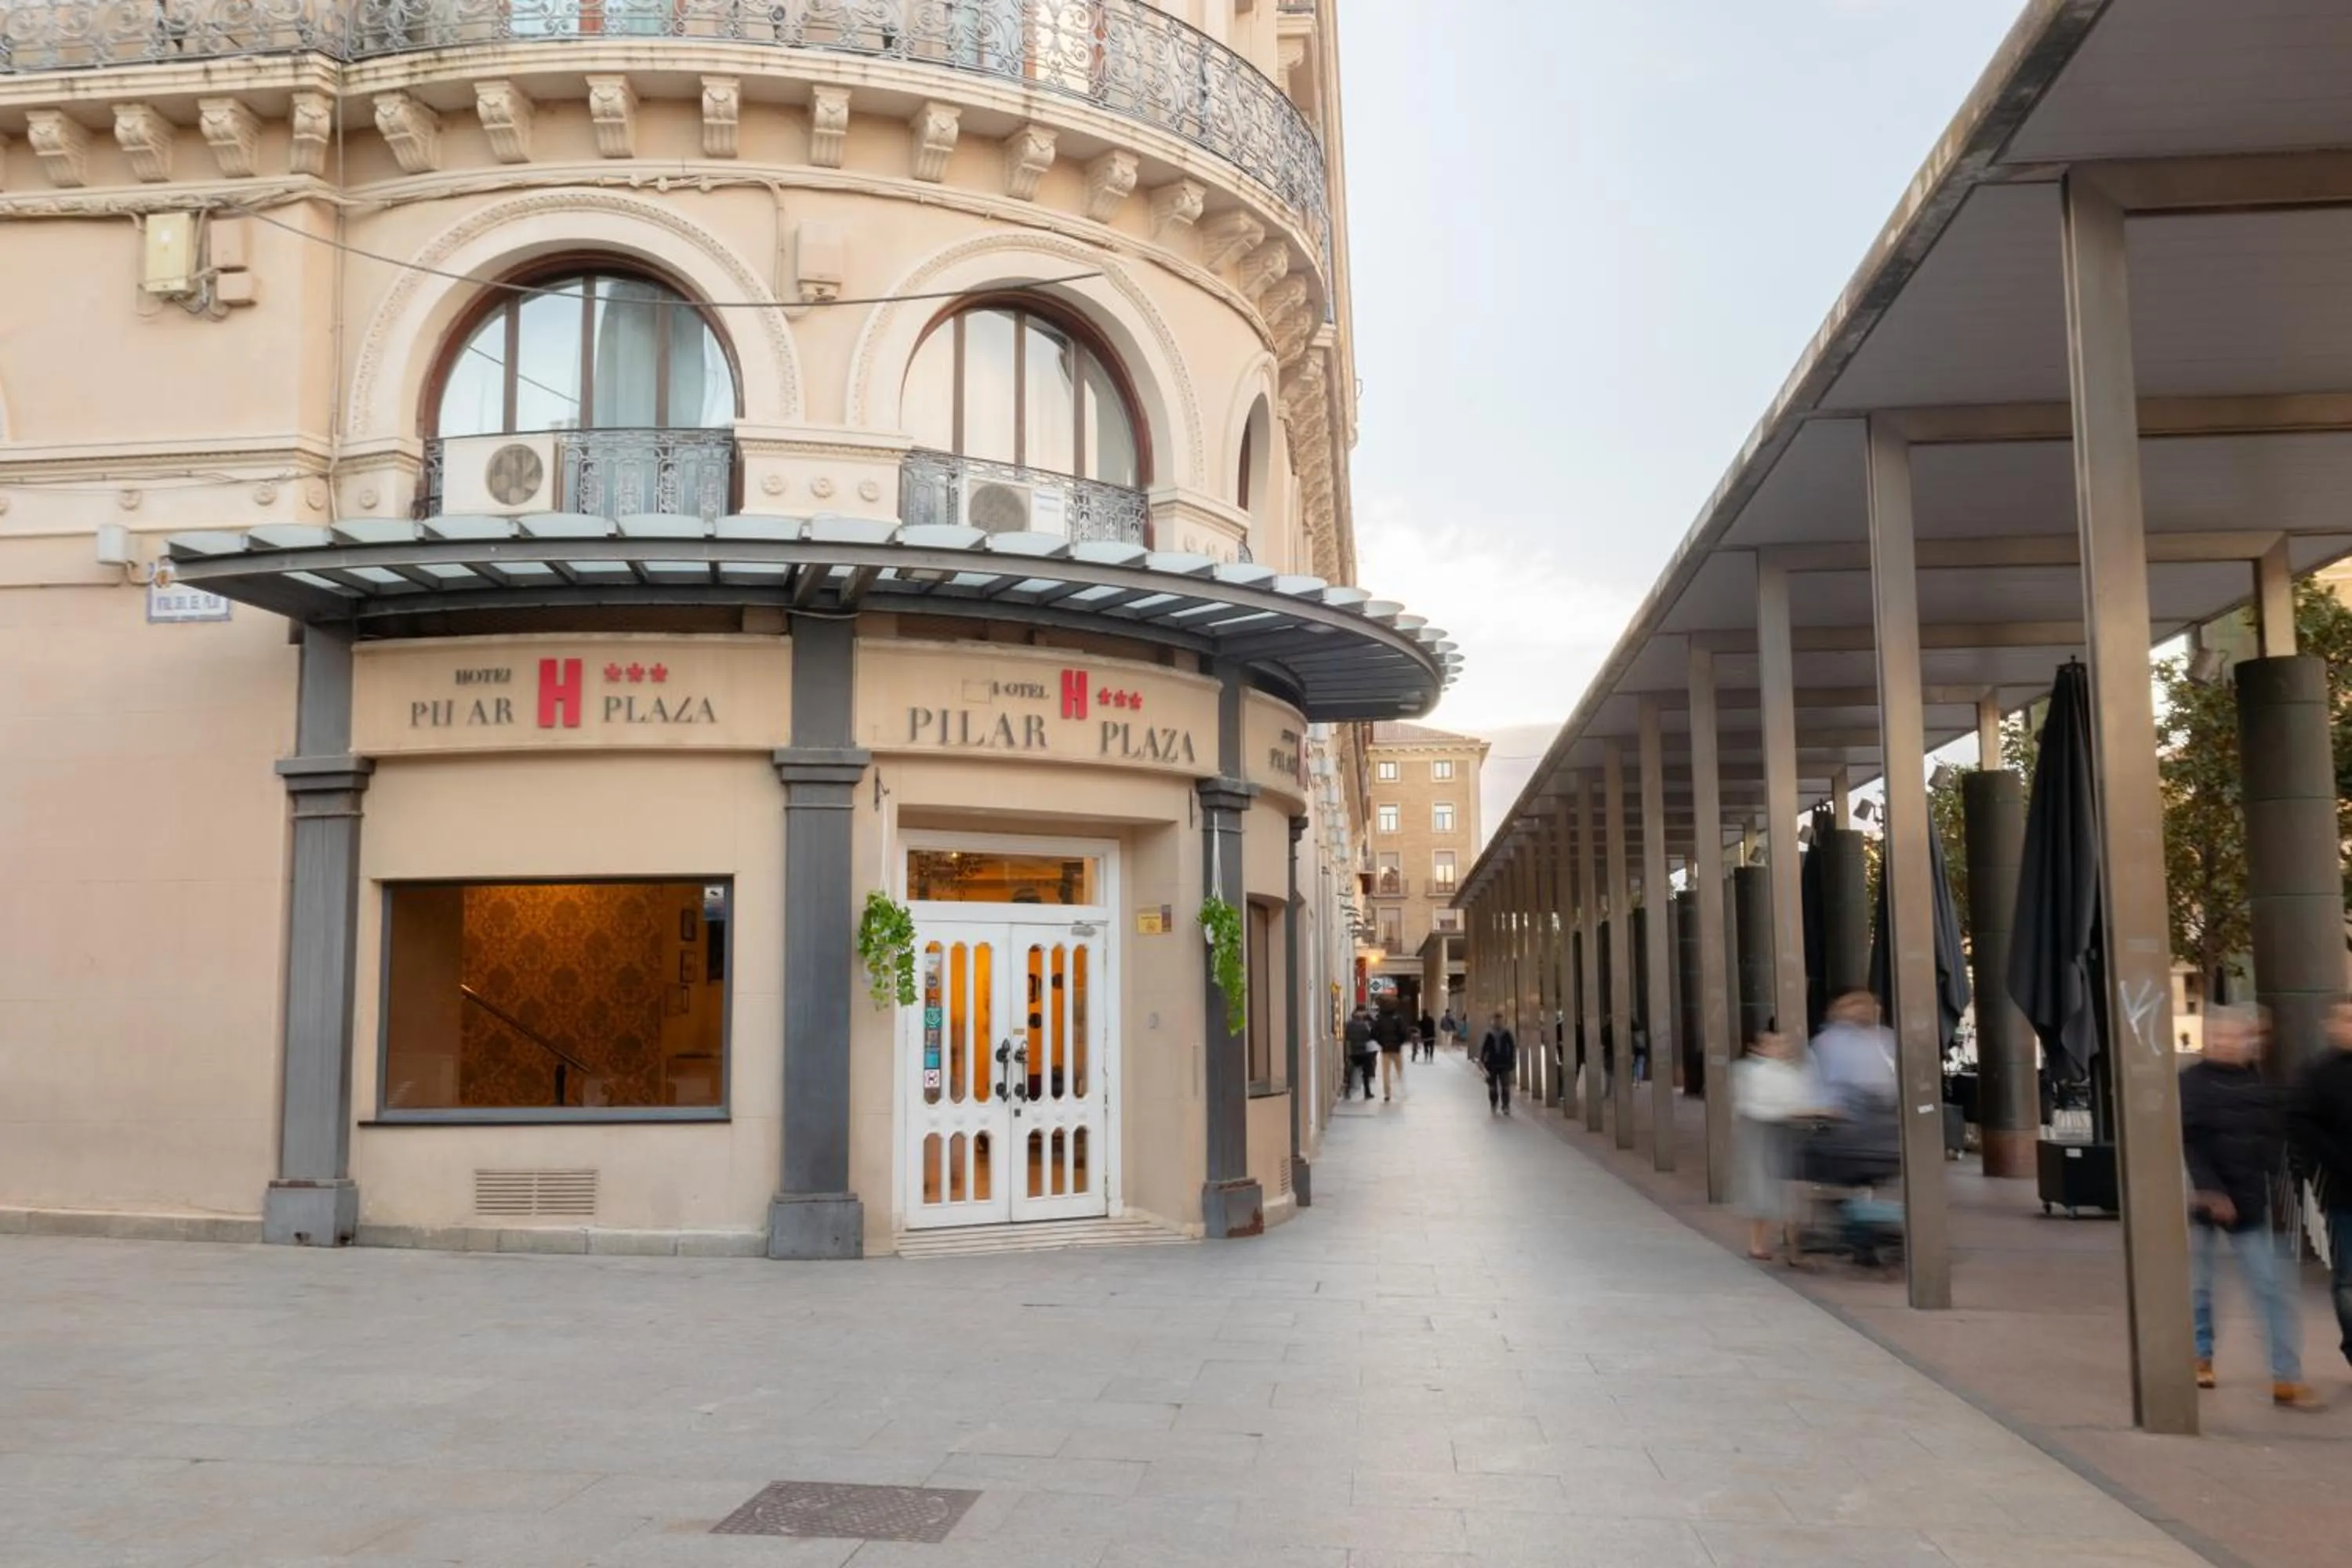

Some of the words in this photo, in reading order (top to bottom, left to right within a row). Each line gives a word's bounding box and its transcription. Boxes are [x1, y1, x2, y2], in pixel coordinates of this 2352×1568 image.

[538, 658, 582, 728] H
[602, 694, 717, 724] PLAZA
[1061, 669, 1087, 720] H
[907, 706, 1047, 749] PILAR
[1100, 720, 1196, 764] PLAZA
